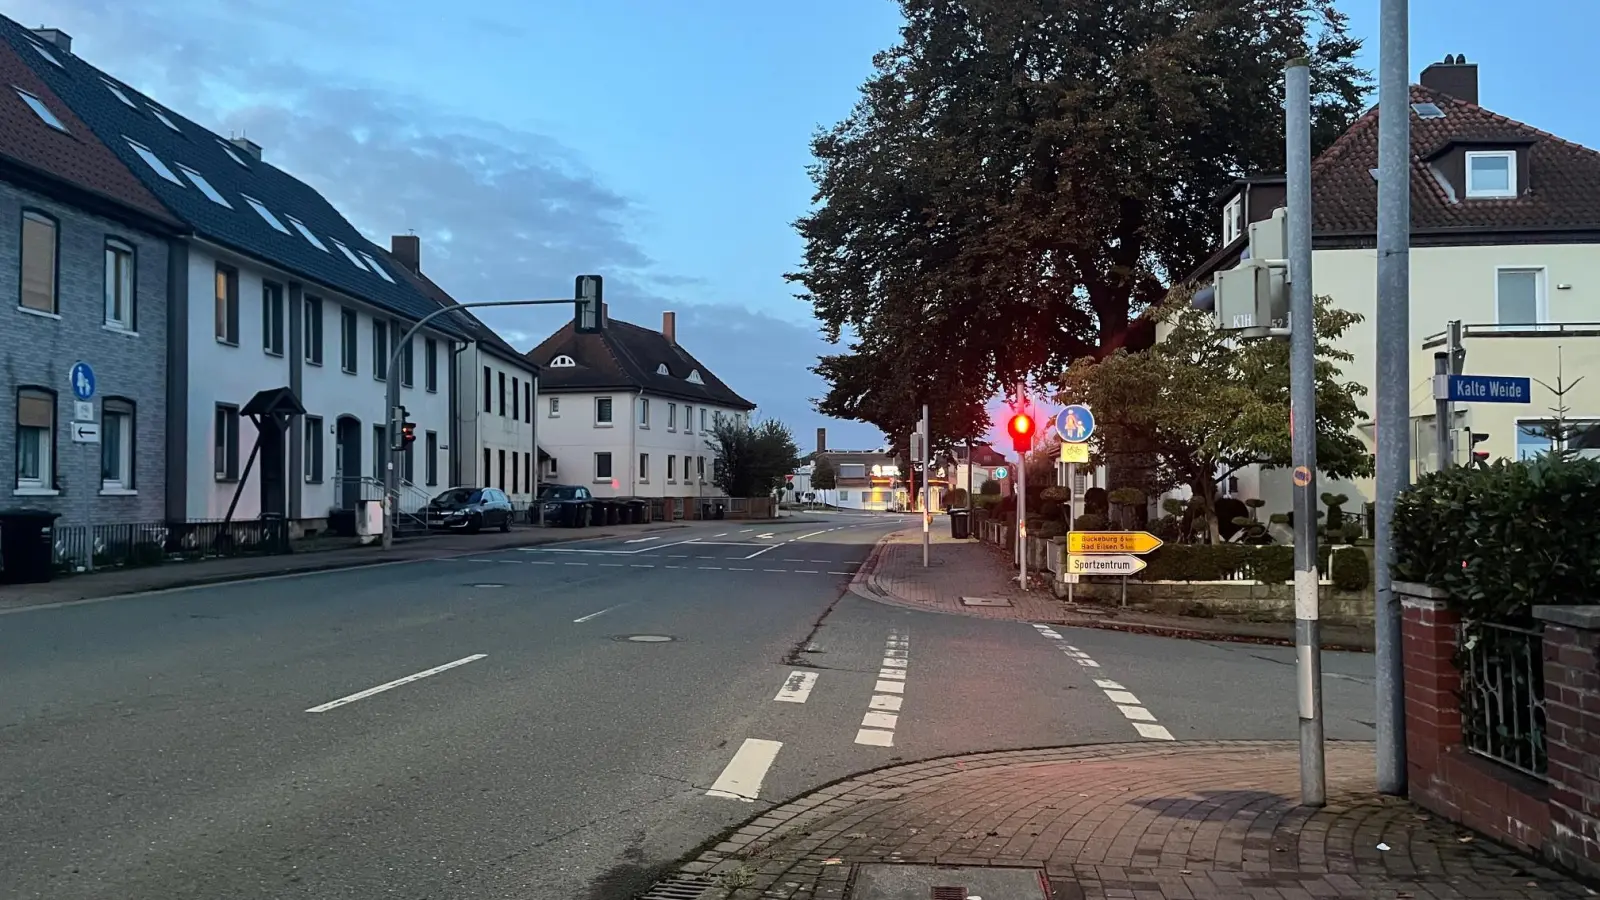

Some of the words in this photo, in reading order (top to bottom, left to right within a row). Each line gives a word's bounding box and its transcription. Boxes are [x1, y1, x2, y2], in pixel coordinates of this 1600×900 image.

[1456, 380, 1486, 396] Kalte
[1489, 381, 1522, 397] Weide
[1074, 559, 1130, 571] Sportzentrum
